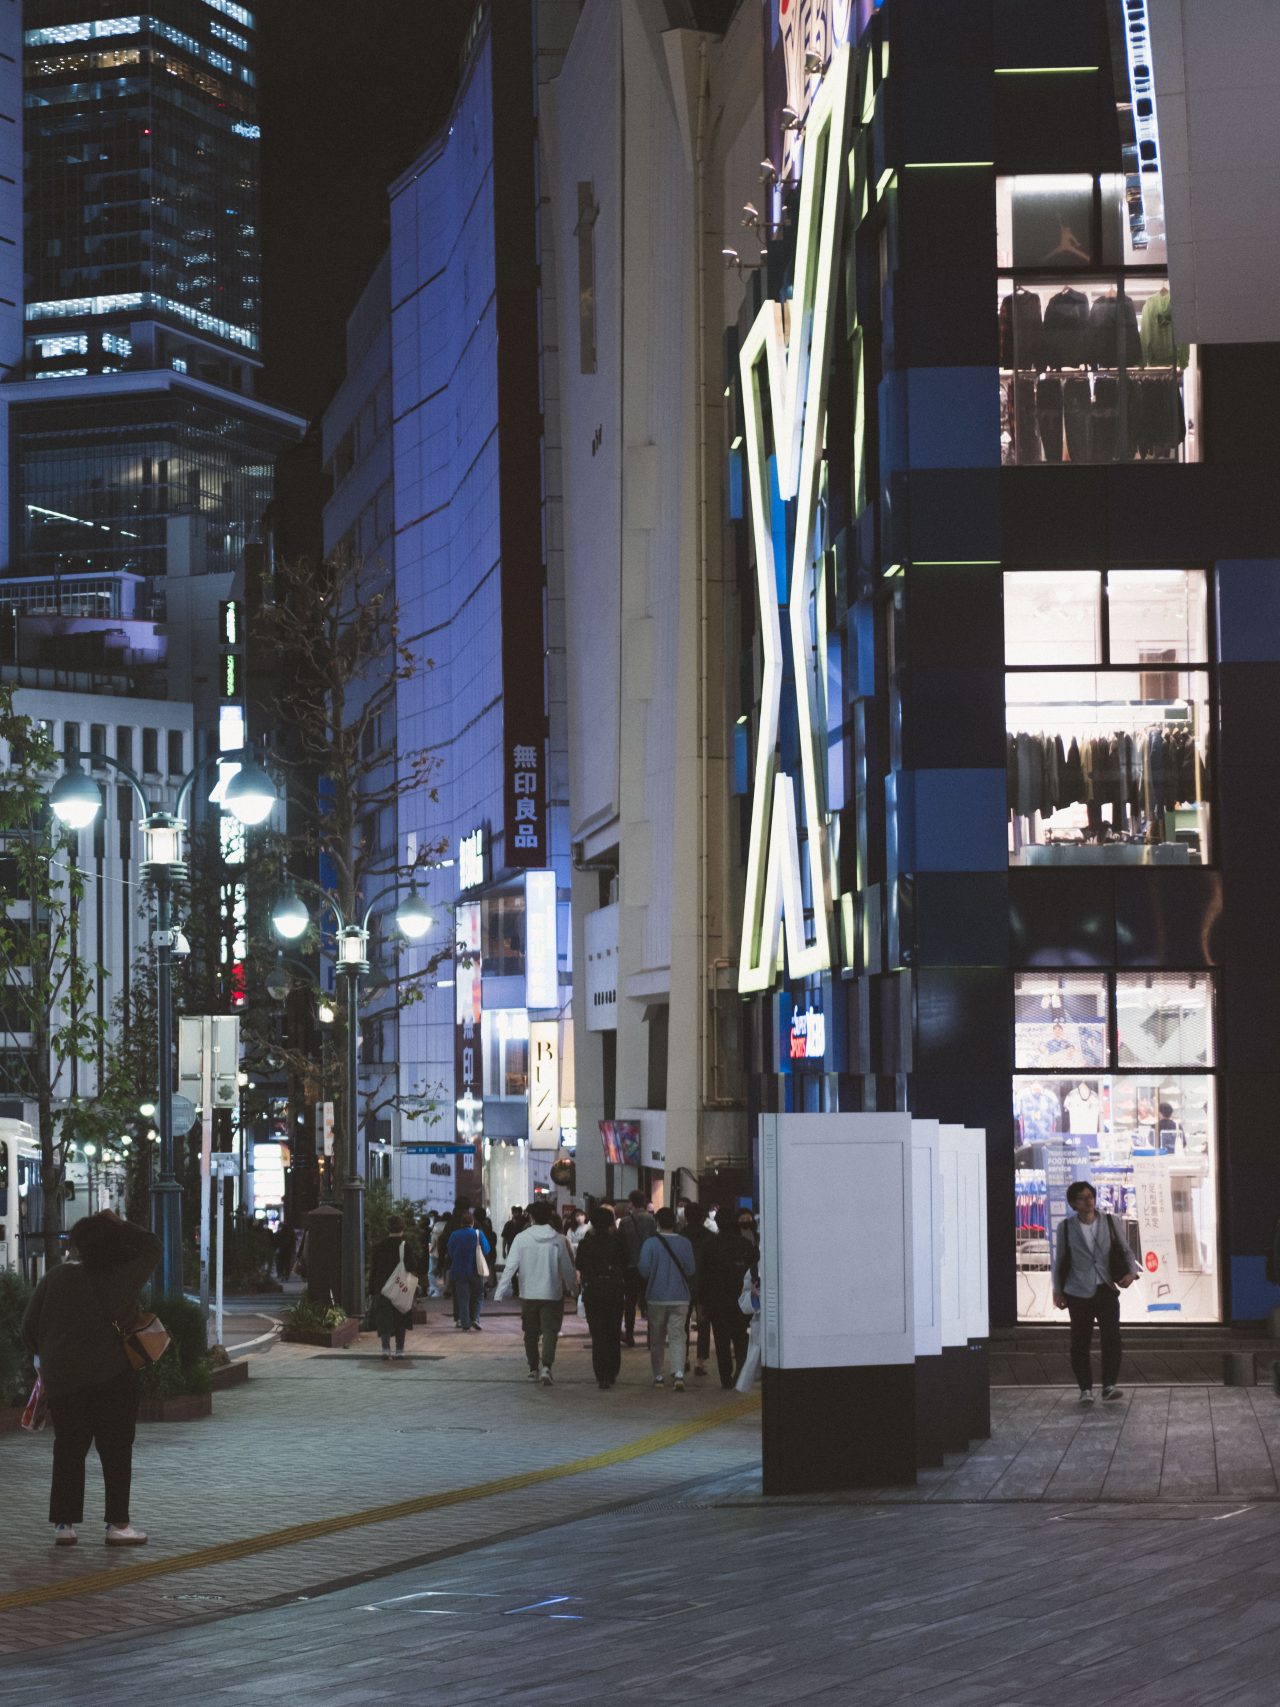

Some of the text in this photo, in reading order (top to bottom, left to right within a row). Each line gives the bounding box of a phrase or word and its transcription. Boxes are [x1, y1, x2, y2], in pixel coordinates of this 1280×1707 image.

[513, 745, 538, 848] 無印良品
[1047, 1156, 1088, 1165] FOOTWEAR
